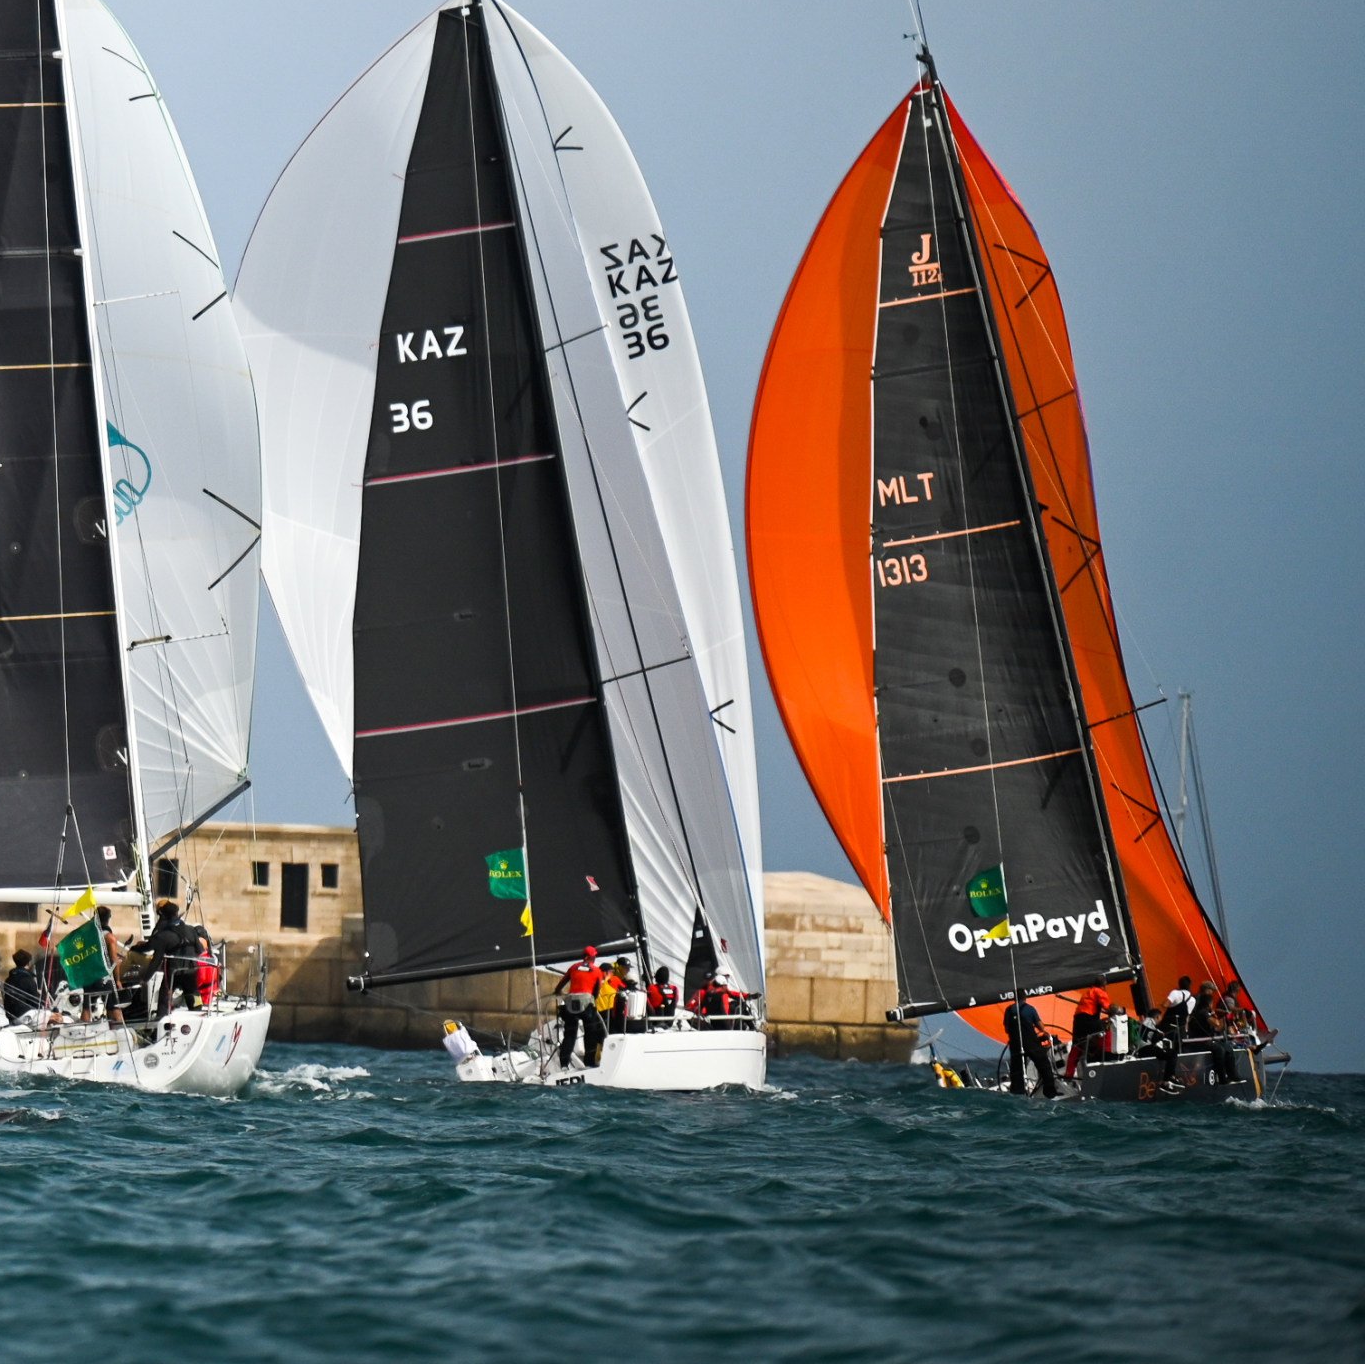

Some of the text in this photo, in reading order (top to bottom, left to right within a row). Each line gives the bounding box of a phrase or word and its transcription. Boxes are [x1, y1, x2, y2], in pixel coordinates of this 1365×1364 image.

[911, 233, 932, 265] J
[607, 256, 678, 298] KAZ
[397, 326, 467, 363] KAZ
[622, 323, 670, 360] 36
[389, 399, 433, 434] 36
[877, 472, 935, 506] MLT
[877, 553, 929, 587] 1313
[489, 869, 522, 878] ROLEX
[969, 888, 1002, 898] ROLEX
